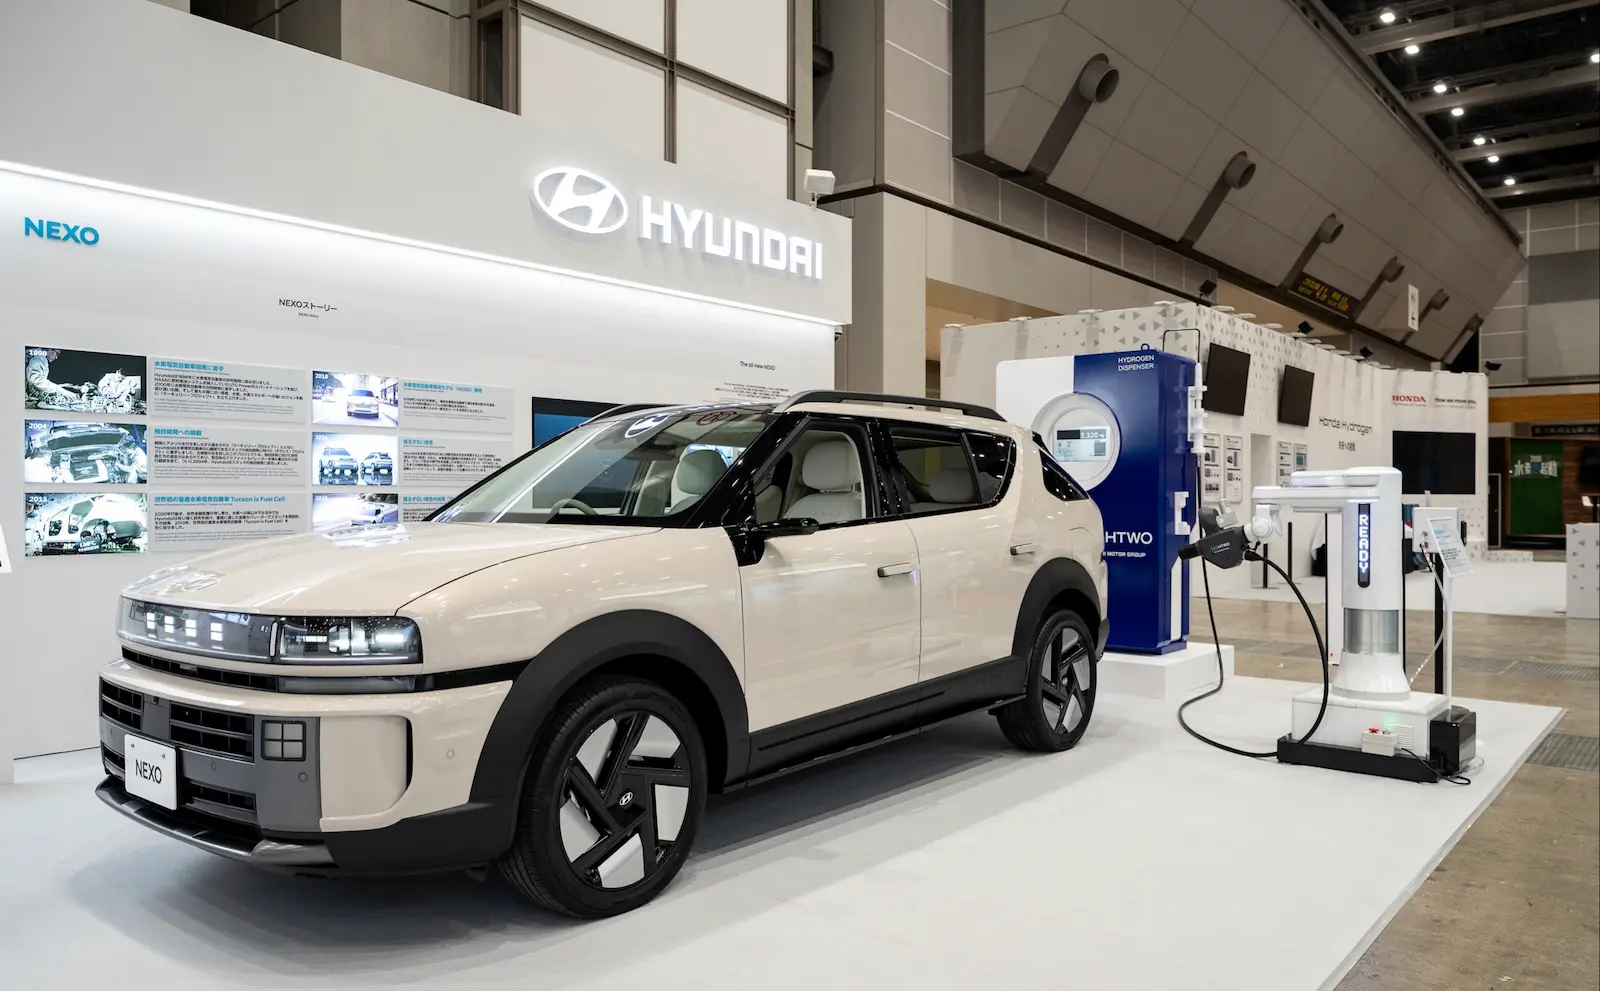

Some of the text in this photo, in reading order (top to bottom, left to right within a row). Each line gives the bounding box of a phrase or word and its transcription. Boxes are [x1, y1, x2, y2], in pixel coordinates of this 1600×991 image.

[24, 216, 99, 245] NEXO
[641, 195, 823, 279] HYUNDAI
[278, 298, 338, 312] NEXOストーリー
[28, 349, 47, 357] 1998
[1117, 354, 1155, 364] HYDROGEN
[1117, 363, 1154, 371] DISPENSER
[1392, 394, 1426, 403] HONDA
[28, 422, 47, 430] 2004
[1319, 415, 1373, 436] Honda Hydrogen
[1105, 530, 1153, 545] HTWO
[1358, 514, 1370, 574] READY
[136, 759, 162, 784] NEXO
